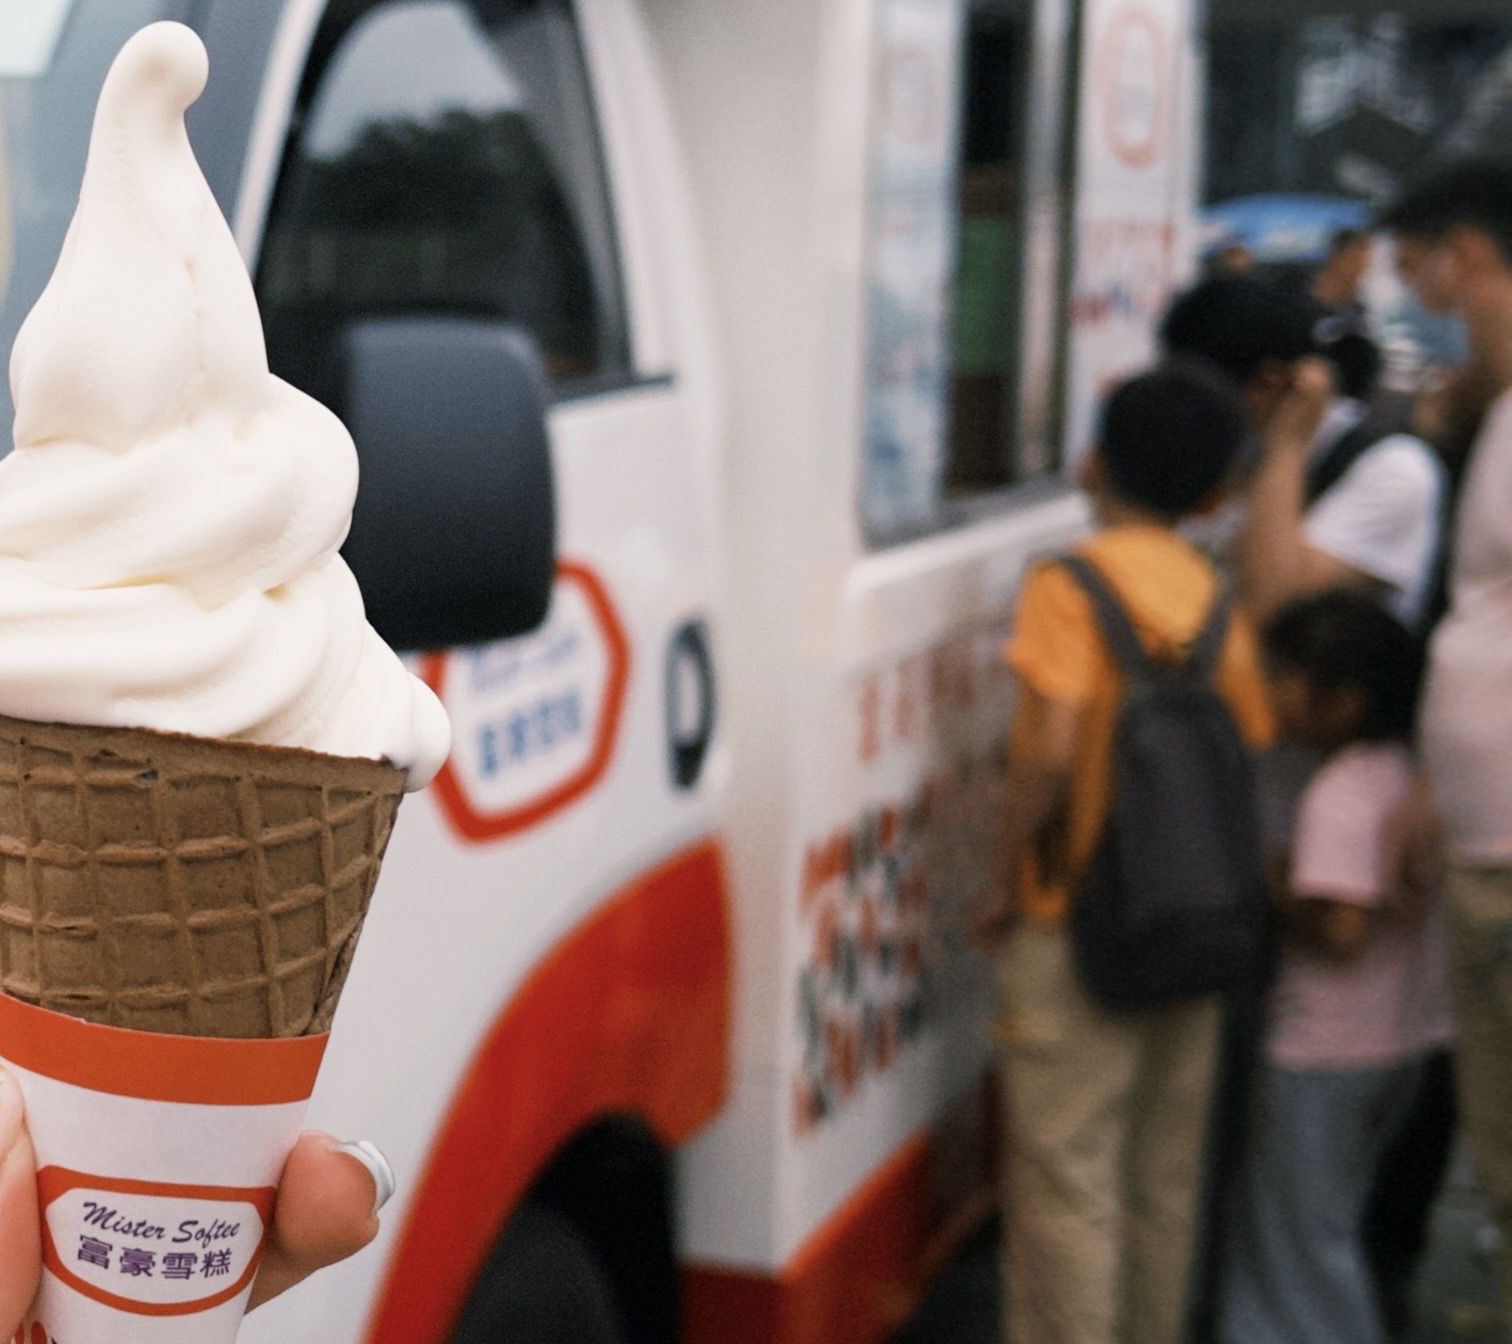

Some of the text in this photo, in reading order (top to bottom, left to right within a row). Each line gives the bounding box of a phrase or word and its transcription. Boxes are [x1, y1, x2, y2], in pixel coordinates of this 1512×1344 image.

[83, 1201, 240, 1249] Mister Softee
[77, 1234, 233, 1281] 富豪雪糕
